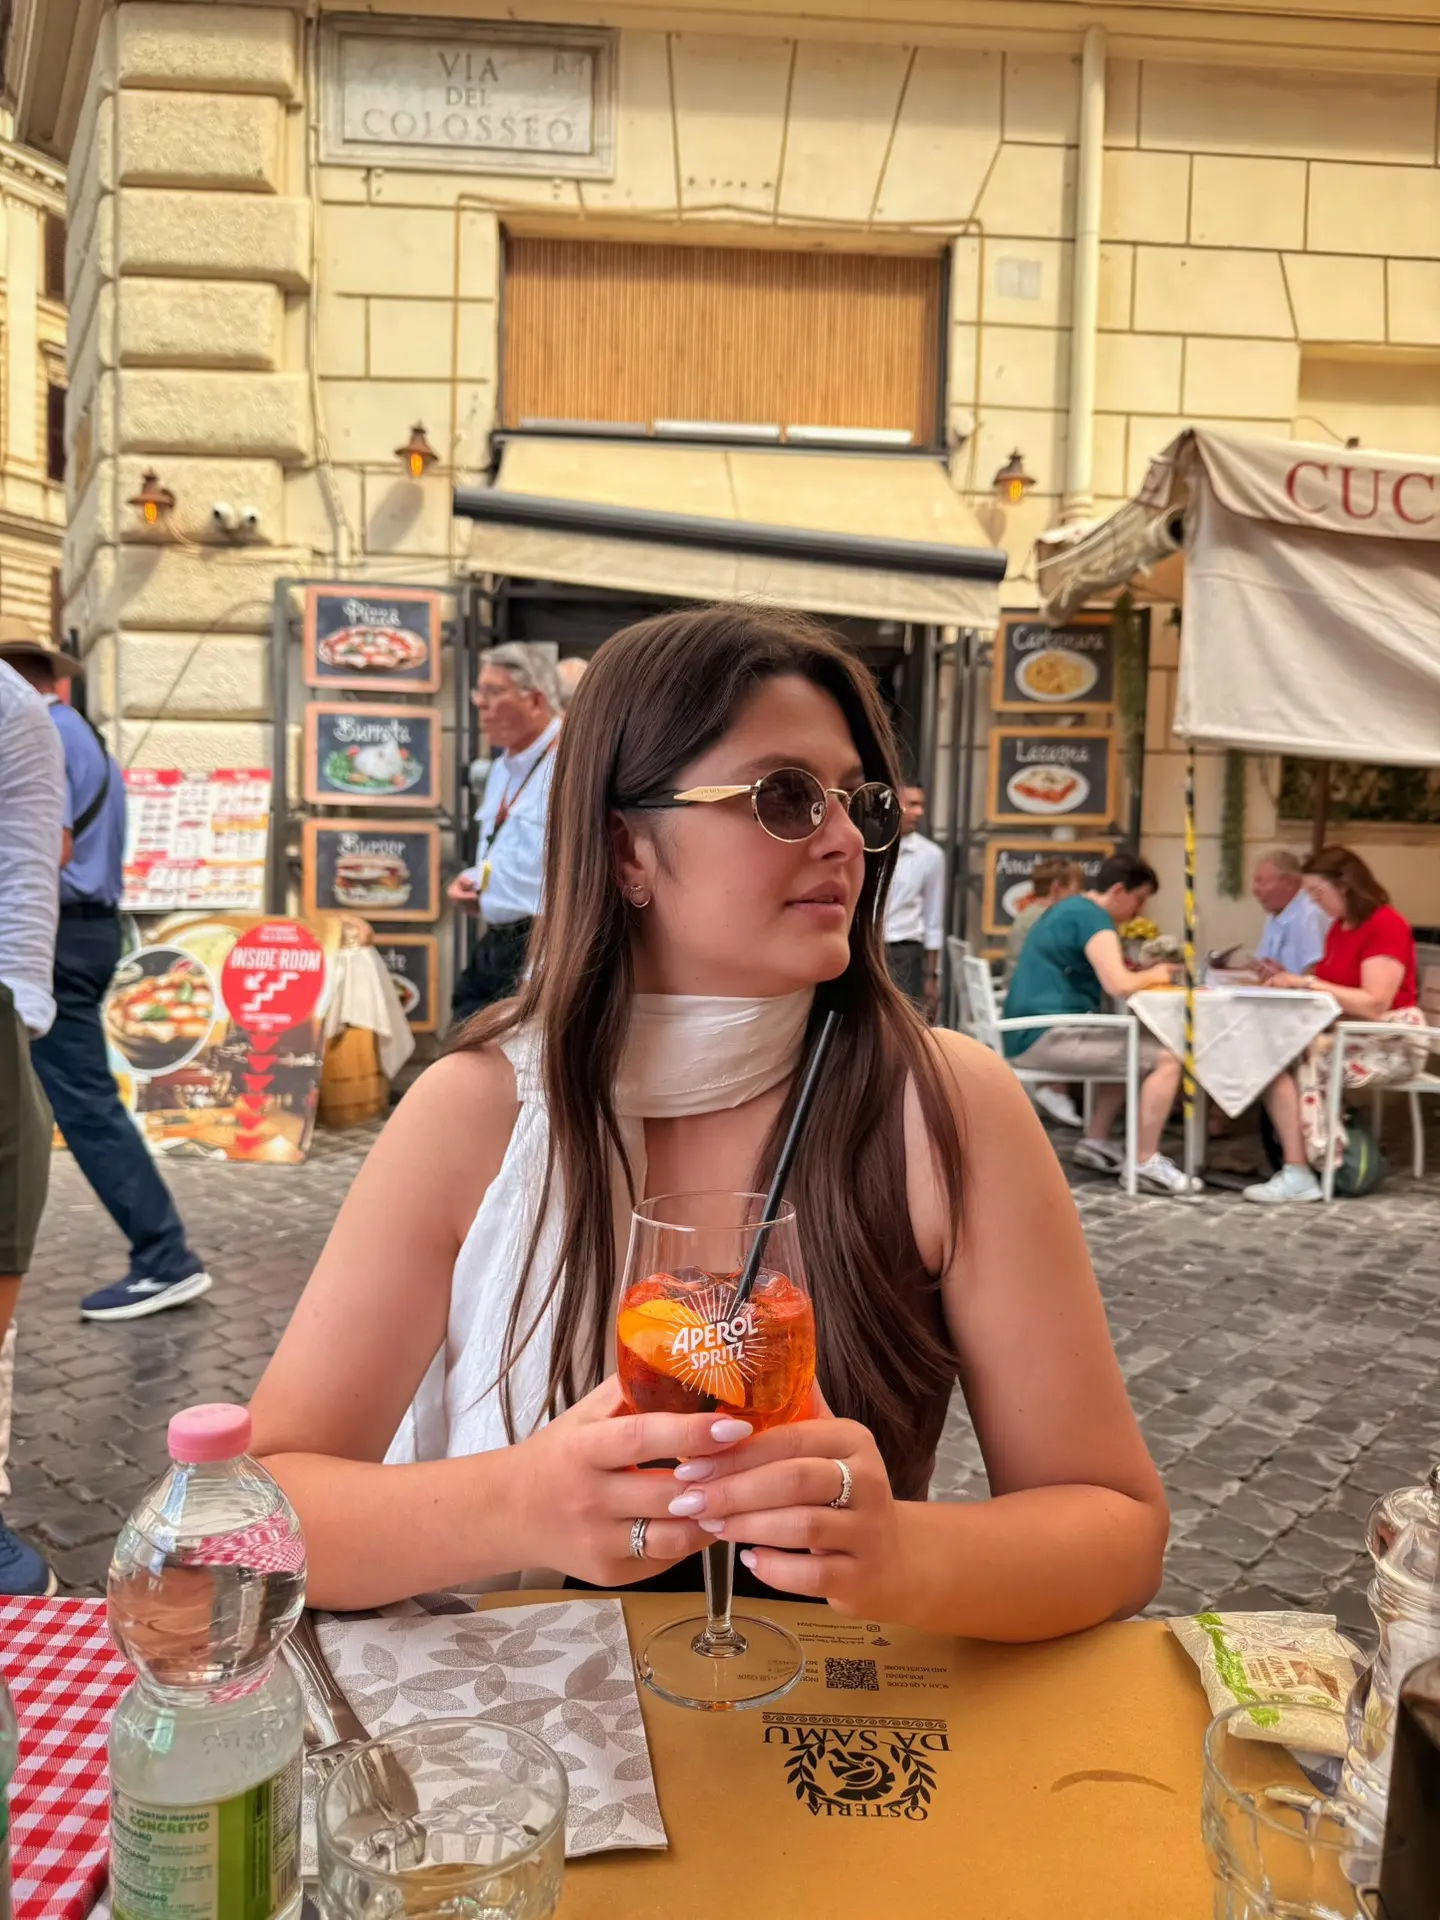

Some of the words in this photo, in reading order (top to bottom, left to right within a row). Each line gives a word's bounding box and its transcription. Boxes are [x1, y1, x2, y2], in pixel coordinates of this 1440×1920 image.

[438, 52, 499, 82] VIA
[445, 85, 494, 108] DEL
[361, 108, 574, 145] COLOSSEO
[1284, 460, 1435, 525] CUC
[230, 947, 277, 971] INSIDE
[278, 948, 322, 973] ROOM
[670, 1312, 759, 1356] APEROL
[690, 1340, 746, 1370] SPRITZ
[762, 1725, 879, 1751] SAMU
[891, 1731, 953, 1752] DA
[129, 1815, 210, 1833] CONCRETO
[805, 1803, 928, 1822] OSTERIA
